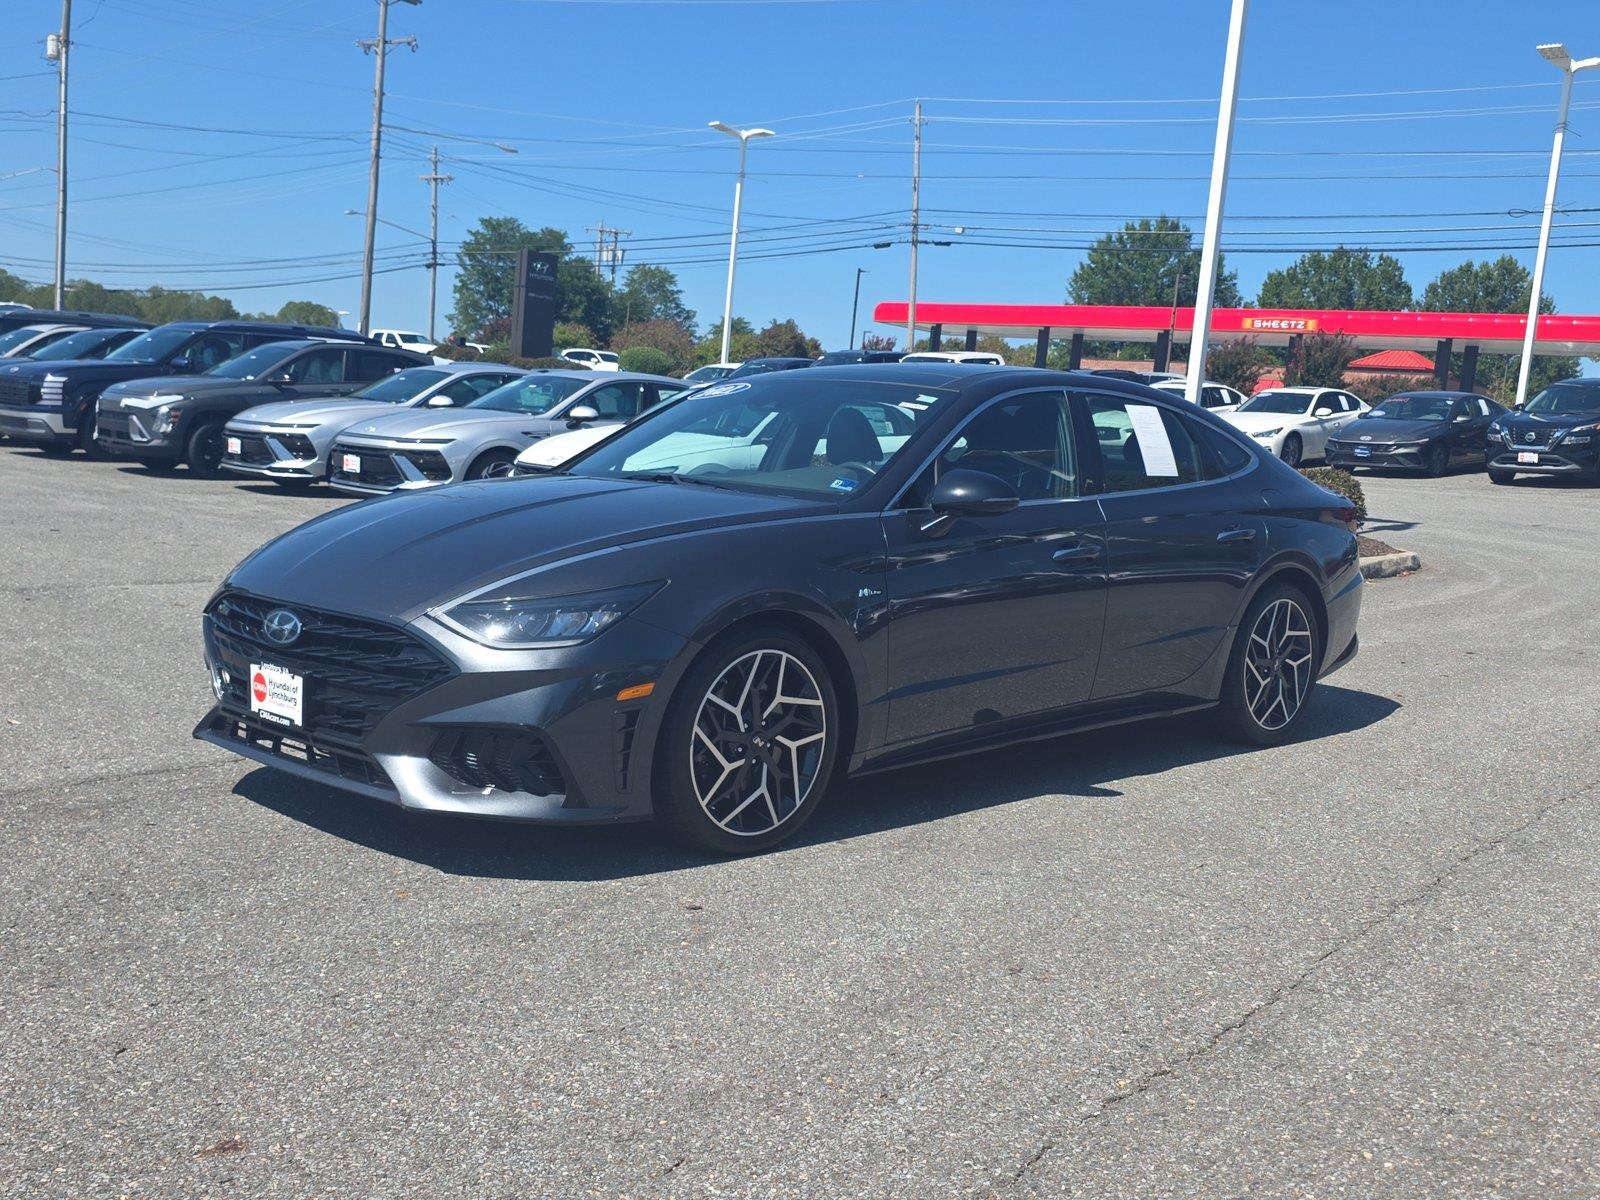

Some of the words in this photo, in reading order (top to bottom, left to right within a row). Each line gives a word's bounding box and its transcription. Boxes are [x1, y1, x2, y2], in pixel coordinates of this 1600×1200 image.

[1253, 319, 1306, 329] SHEETZ
[268, 678, 292, 692] Hyundai
[292, 686, 298, 695] of
[268, 689, 298, 706] Lynchburg
